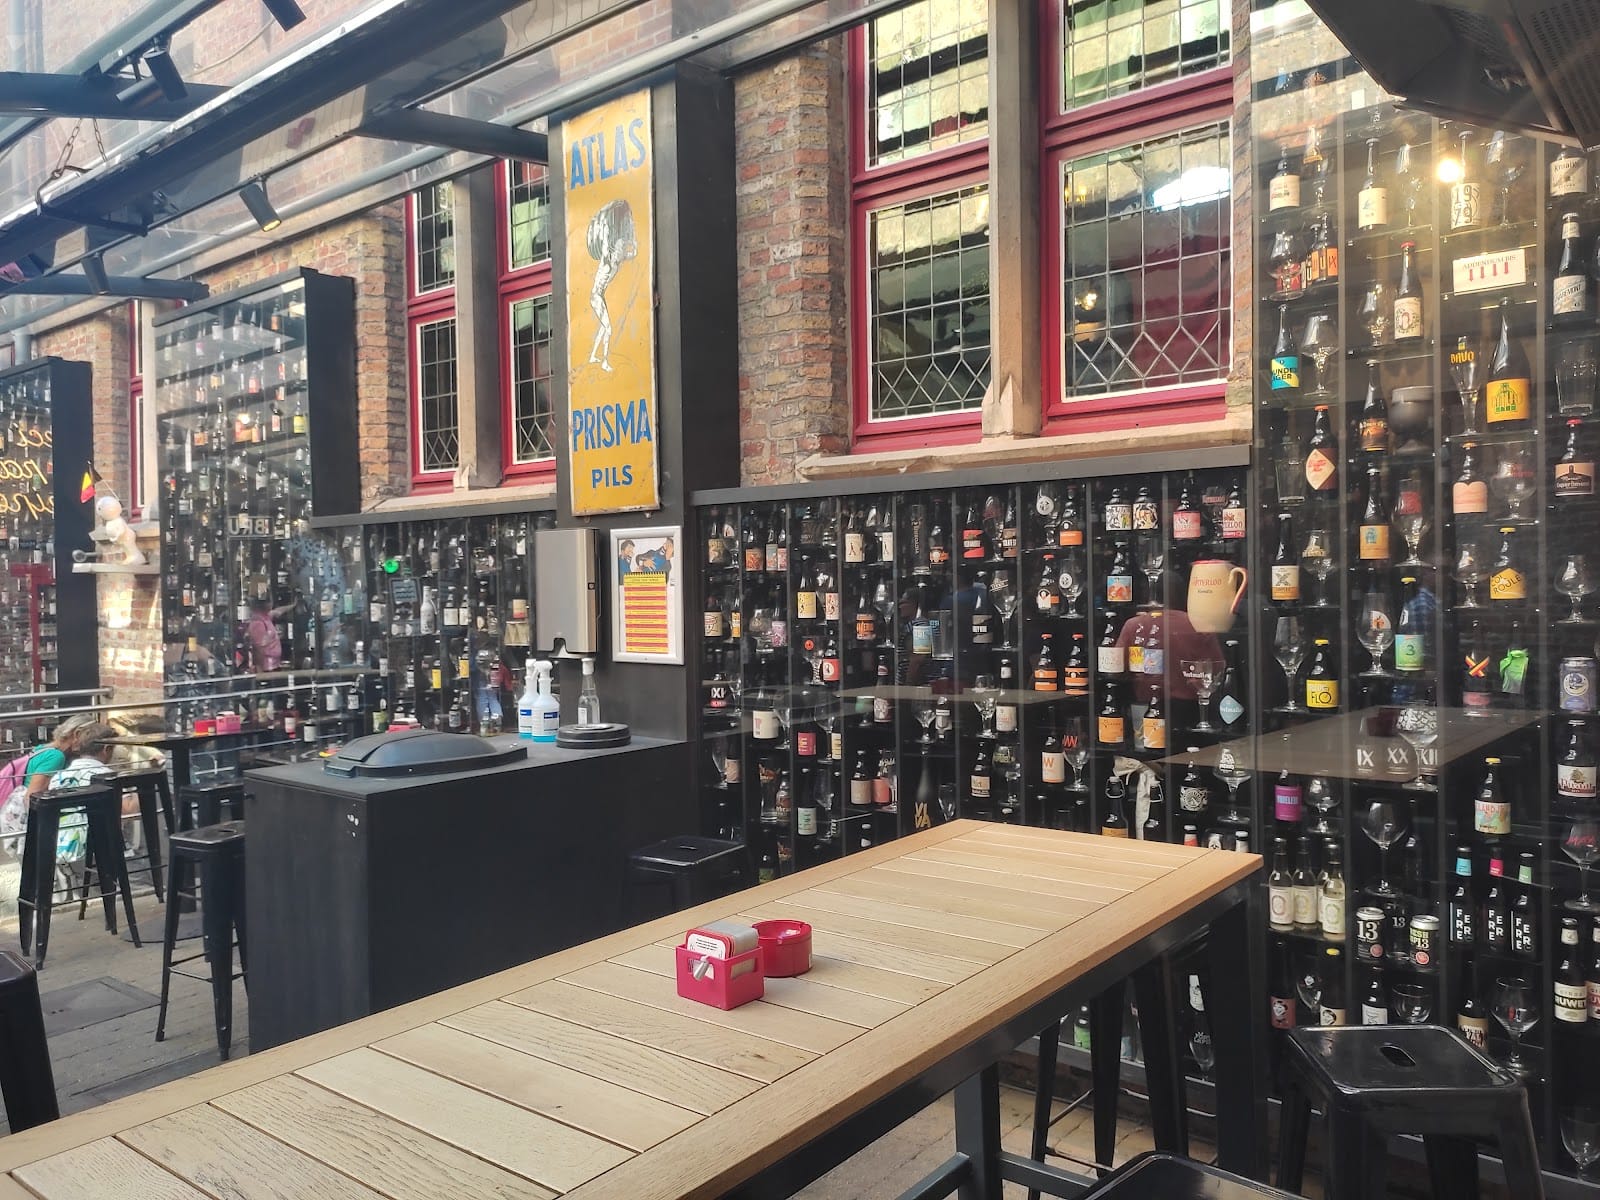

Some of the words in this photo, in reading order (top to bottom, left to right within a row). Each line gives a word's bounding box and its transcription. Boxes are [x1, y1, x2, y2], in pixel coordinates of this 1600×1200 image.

[571, 118, 646, 190] ATLAS
[573, 399, 651, 451] PRISMA
[592, 465, 633, 489] PILS
[1406, 644, 1415, 656] 3
[1357, 920, 1379, 940] 13
